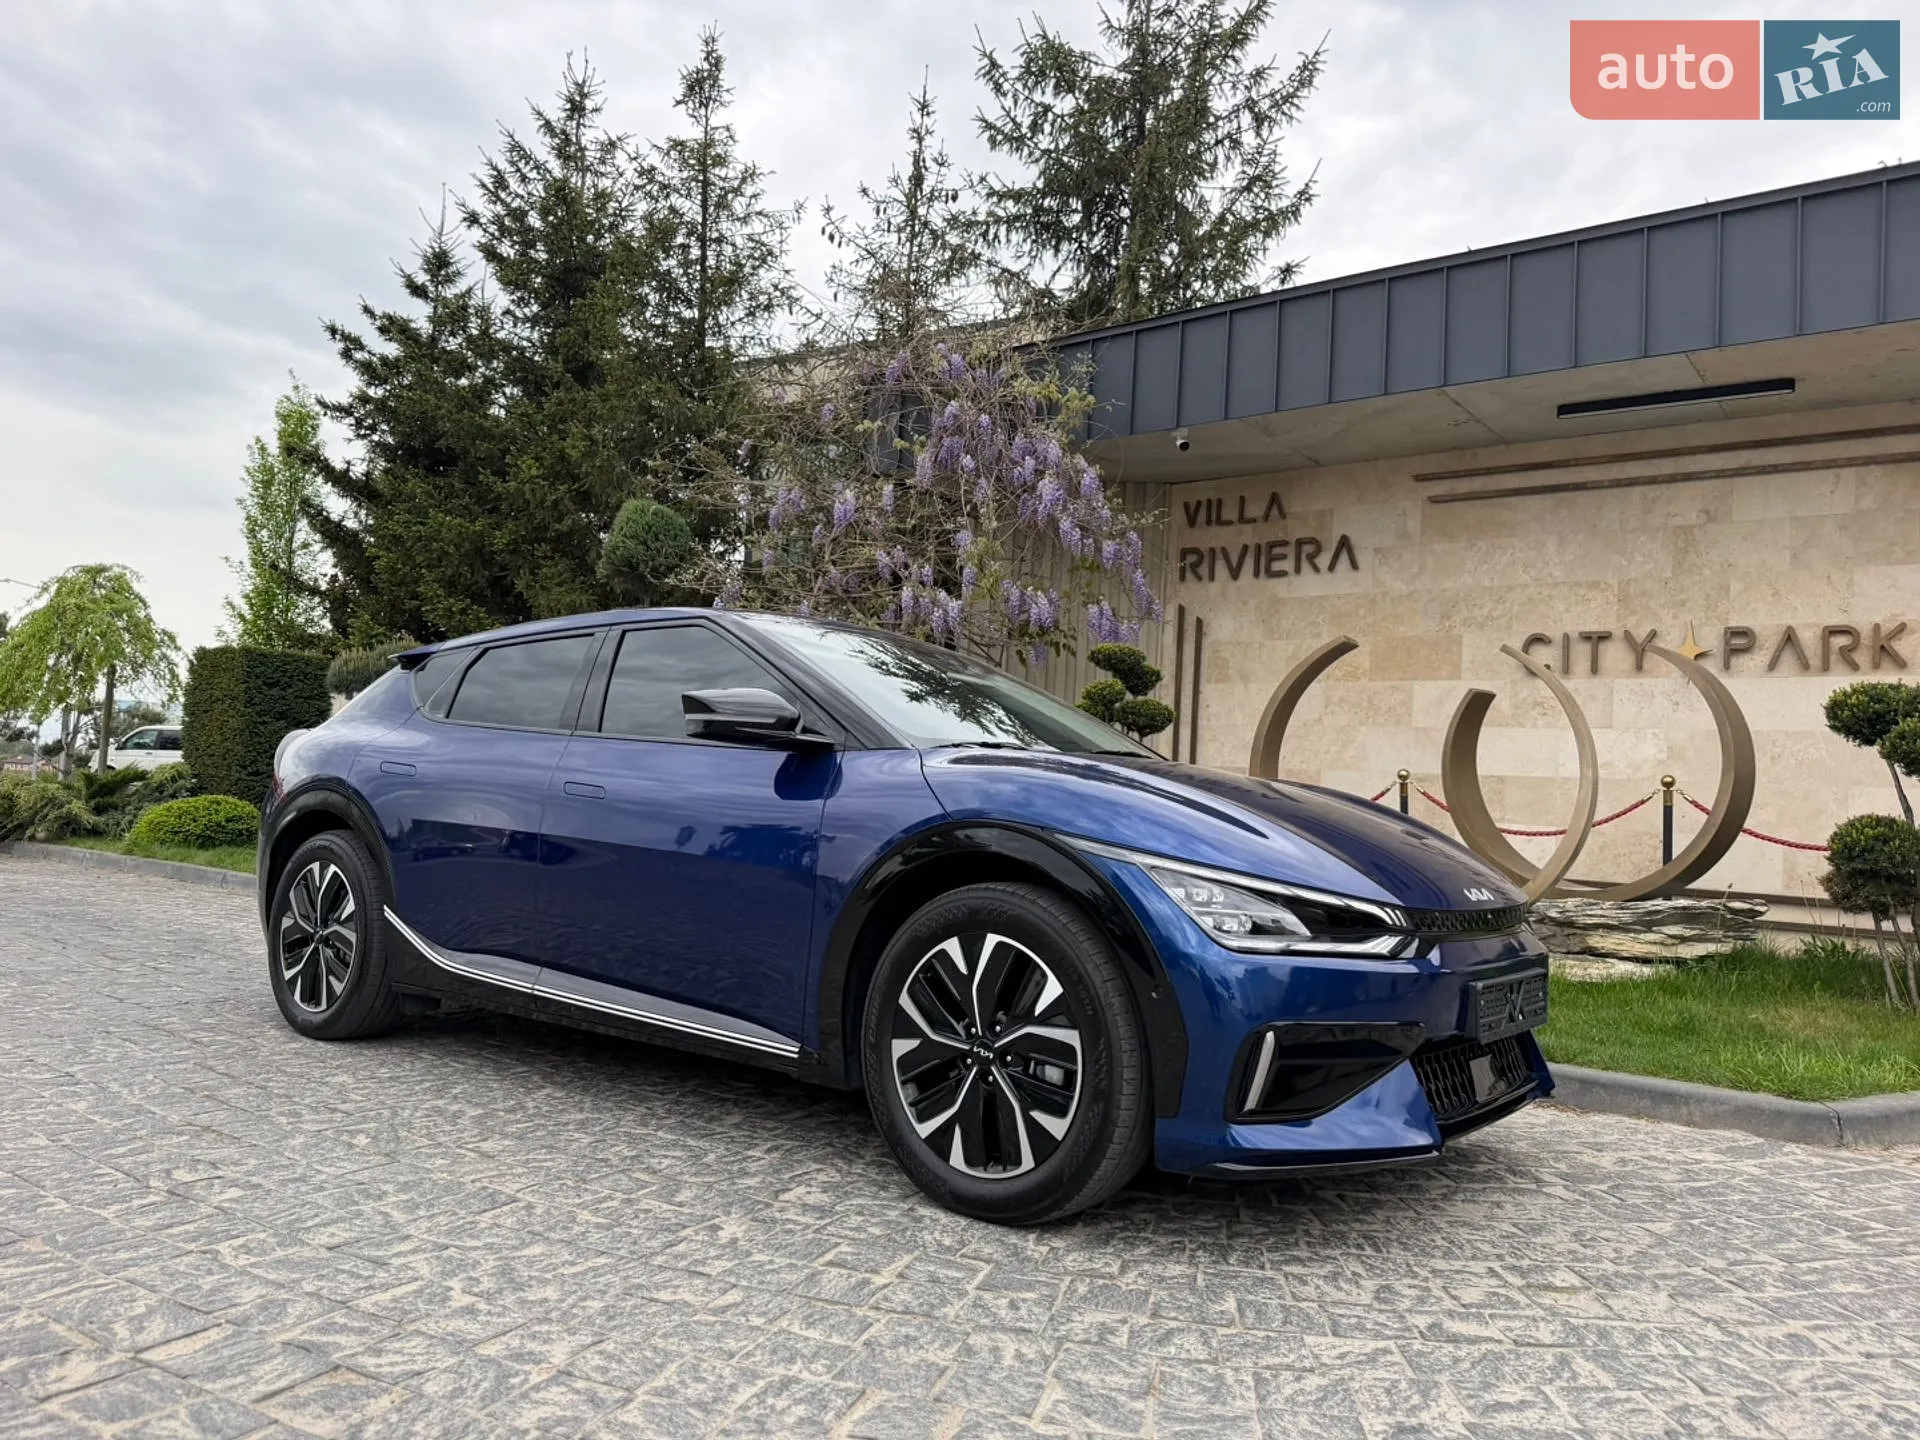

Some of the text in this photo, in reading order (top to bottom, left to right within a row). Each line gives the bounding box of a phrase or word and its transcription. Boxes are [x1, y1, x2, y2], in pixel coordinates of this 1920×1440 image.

[1183, 491, 1287, 529] VILLA
[1179, 534, 1360, 583] RIVIERA
[1521, 622, 1908, 675] CITY PARK
